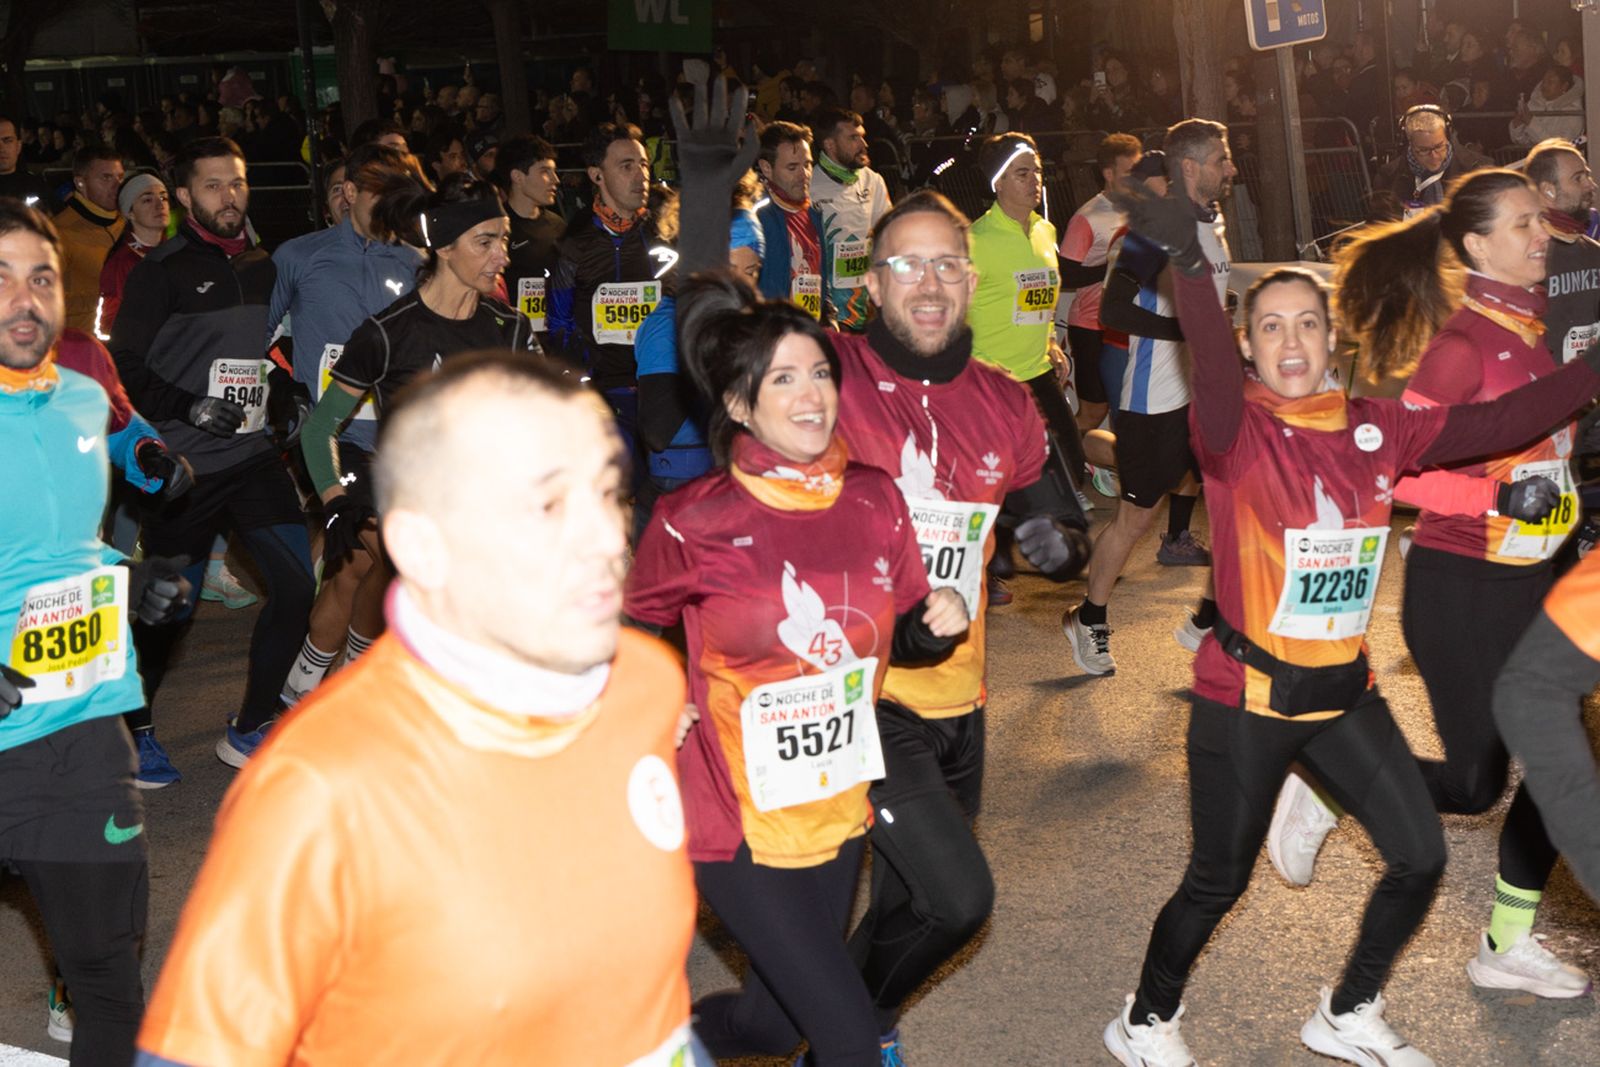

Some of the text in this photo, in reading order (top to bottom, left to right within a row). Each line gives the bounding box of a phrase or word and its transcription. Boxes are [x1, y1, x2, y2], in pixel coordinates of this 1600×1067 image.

[1297, 12, 1320, 27] MOTOS
[1549, 269, 1600, 298] BUNKE
[600, 297, 615, 305] SAN
[1024, 287, 1055, 306] 4526
[605, 303, 651, 324] 5969
[218, 375, 234, 385] SAN
[228, 368, 250, 376] NOCHE
[224, 386, 263, 407] 6948
[911, 511, 964, 528] NOCHE DE
[1312, 542, 1354, 555] NOCHE DE
[1297, 556, 1320, 569] SAN
[1299, 567, 1369, 604] 12236
[27, 594, 67, 613] NOCHE
[68, 590, 82, 604] DE
[23, 612, 101, 663] 8360
[808, 632, 842, 666] 43
[776, 690, 817, 706] NOCHE
[821, 686, 834, 700] DE
[760, 710, 788, 724] SAN
